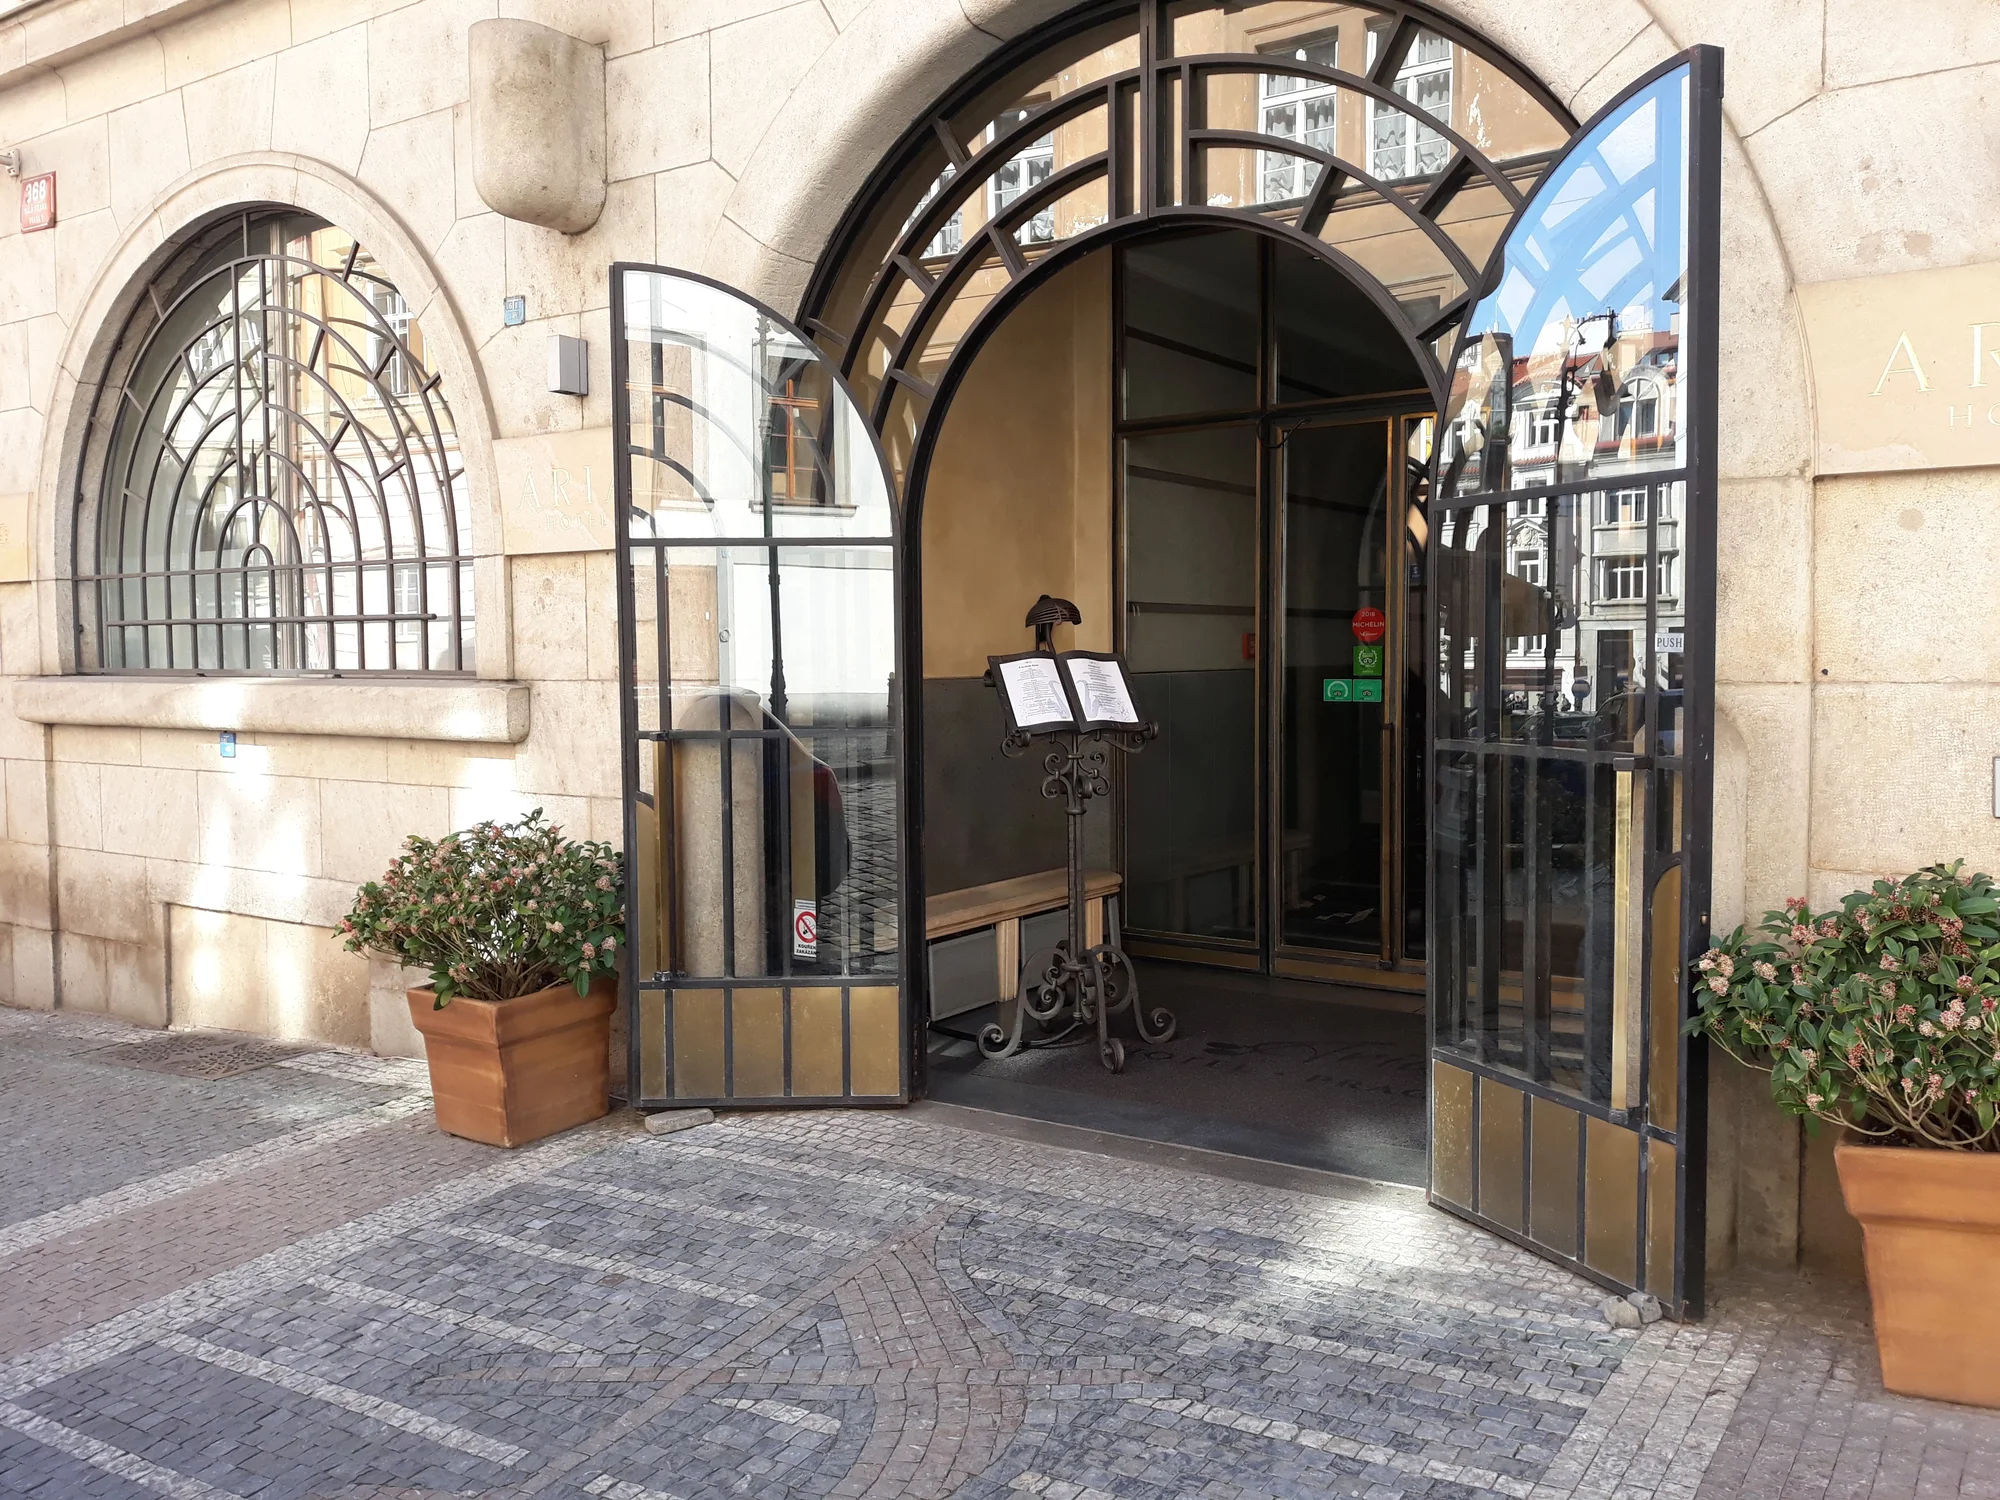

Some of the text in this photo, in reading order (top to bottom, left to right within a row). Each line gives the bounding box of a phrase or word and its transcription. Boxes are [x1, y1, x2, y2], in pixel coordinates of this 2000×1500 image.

[25, 179, 46, 204] 368
[547, 510, 609, 531] HOTEL
[1656, 637, 1683, 648] PUSH
